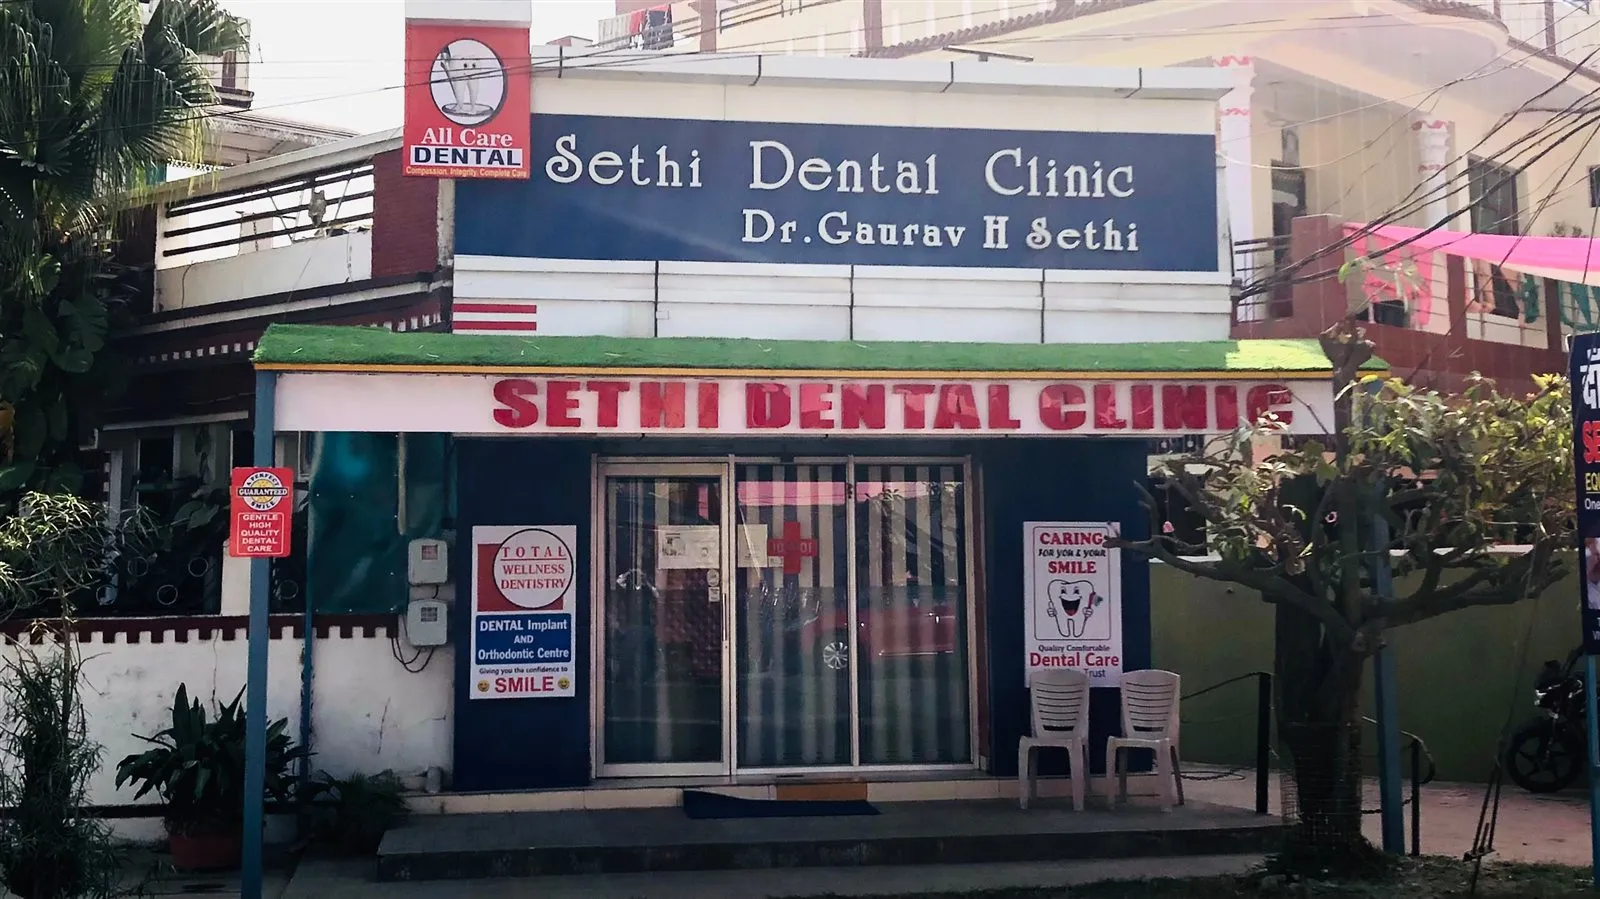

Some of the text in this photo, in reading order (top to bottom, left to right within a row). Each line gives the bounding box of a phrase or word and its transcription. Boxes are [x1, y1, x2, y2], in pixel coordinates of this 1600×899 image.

[420, 127, 513, 147] All Care
[414, 146, 521, 166] DENTAL
[545, 133, 1136, 199] Sethi Dental Clinic
[479, 169, 511, 178] Complete
[511, 169, 527, 178] Care
[982, 214, 1010, 250] H
[1025, 216, 1139, 251] Sethi
[492, 378, 1294, 431] SETHI DENTAL CLINIC
[239, 488, 288, 496] GUARANTEED
[251, 501, 276, 509] SMILE
[240, 529, 280, 537] QUALITY
[1039, 532, 1103, 545] CARING
[242, 537, 278, 545] DENTAL
[501, 546, 567, 558] TOTAL
[502, 563, 565, 575] WELLNESS
[1048, 560, 1097, 574] SMILE
[501, 578, 566, 589] DENTISTRY
[479, 618, 568, 632] DENTAL Implant
[513, 635, 534, 644] AND
[478, 647, 570, 660] Orthodontic Centre
[1038, 644, 1111, 653] Quality Comfortable
[1029, 652, 1119, 667] Dental Care
[479, 667, 500, 676] Giving
[500, 668, 513, 676] you
[514, 666, 525, 674] the
[525, 666, 560, 674] confidence
[494, 676, 555, 693] SMILE
